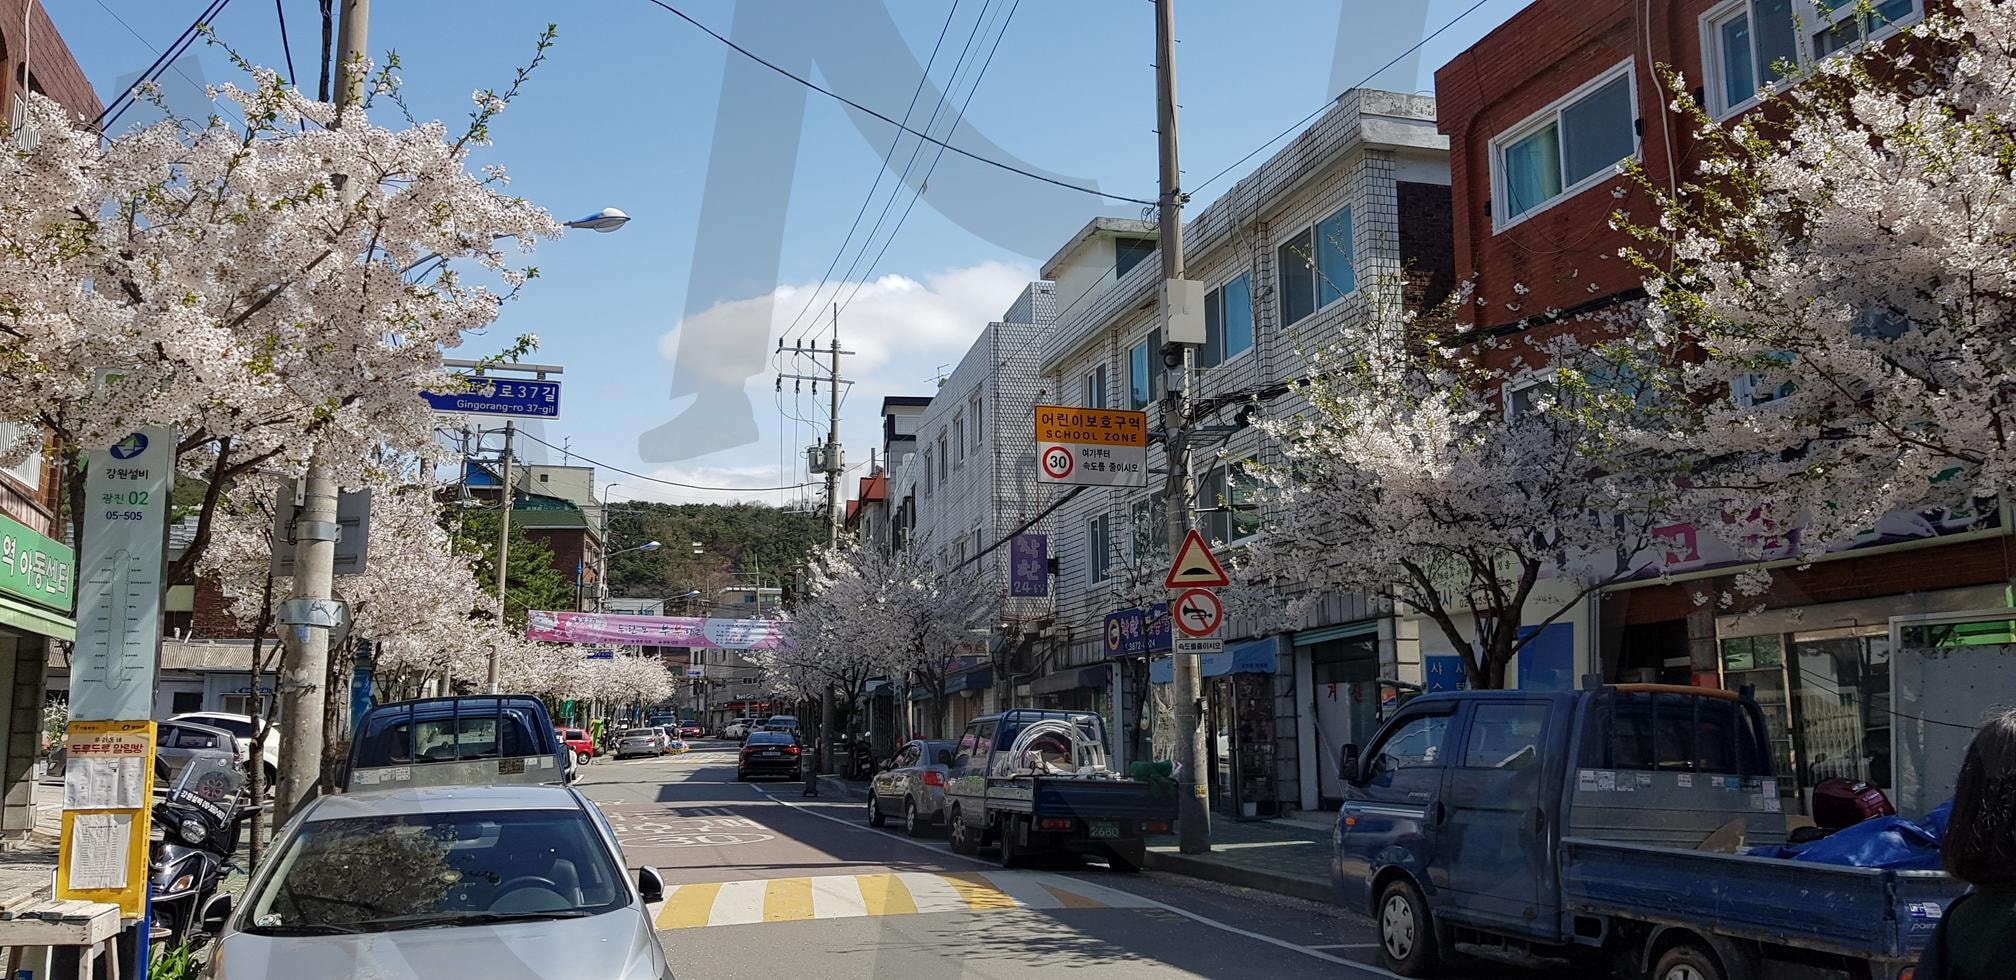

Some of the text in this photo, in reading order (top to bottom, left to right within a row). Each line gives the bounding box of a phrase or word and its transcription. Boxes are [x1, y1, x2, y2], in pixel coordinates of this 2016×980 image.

[456, 399, 554, 414] Gingorang-ro 37-gil
[1041, 413, 1140, 432] 어린이보호구역
[1046, 429, 1137, 443] SCHOOL ZONE
[1082, 448, 1111, 459] 여기부터
[1049, 455, 1067, 469] 30
[1083, 461, 1139, 473] 속도를 줄이시오
[106, 468, 149, 480] 강원설비
[102, 491, 149, 505] 광진 02
[105, 510, 143, 521] 05-505
[19, 548, 70, 600] 아동센터
